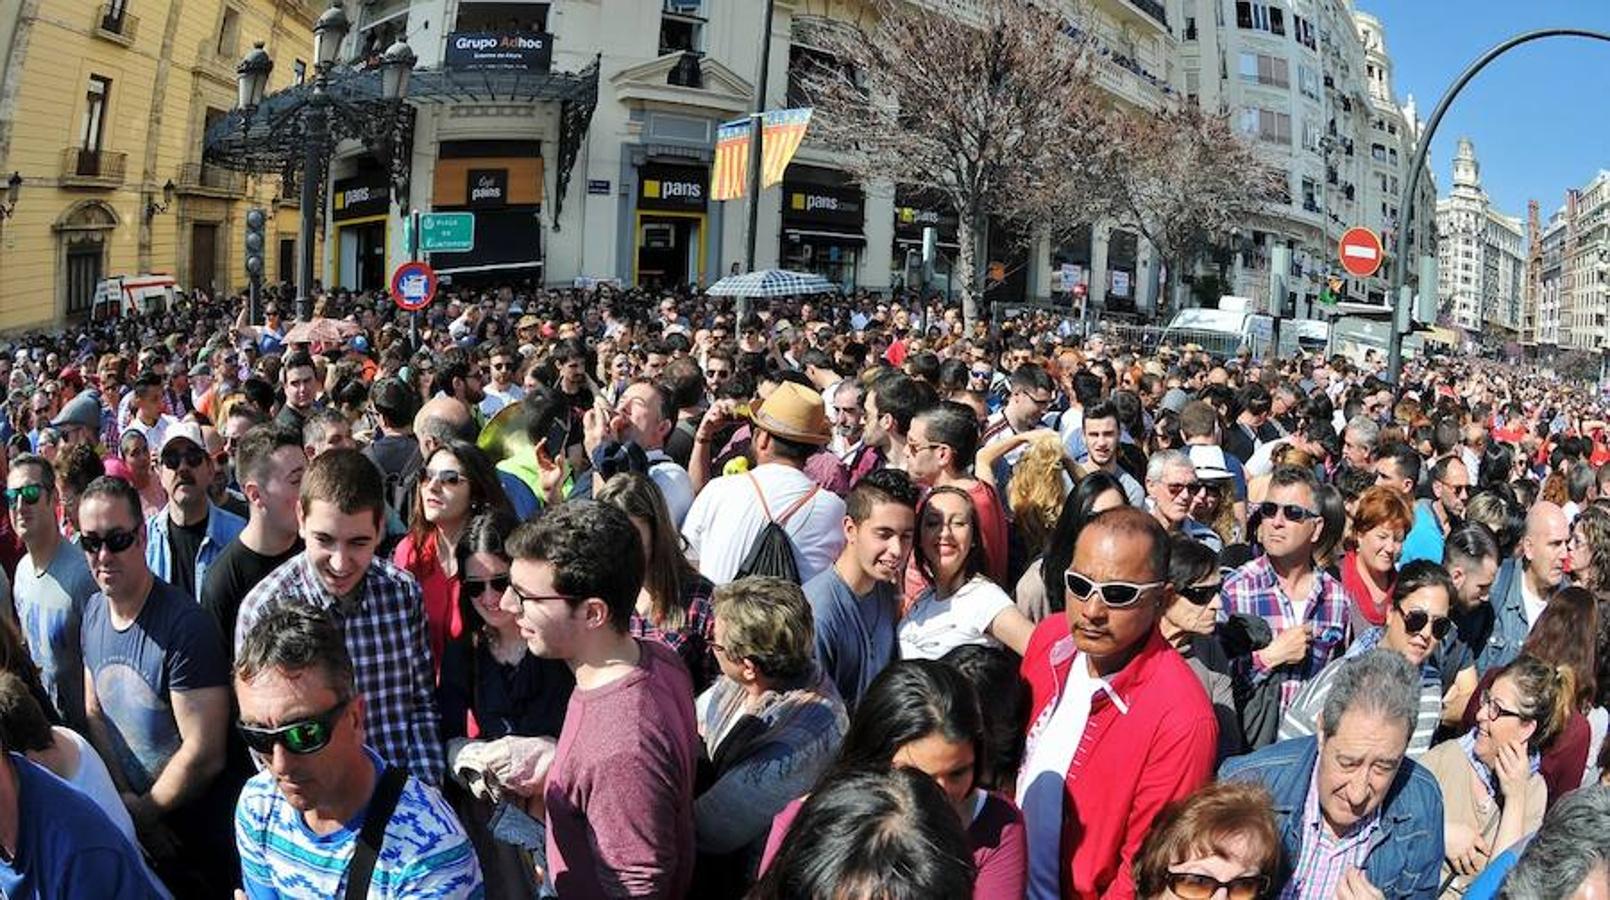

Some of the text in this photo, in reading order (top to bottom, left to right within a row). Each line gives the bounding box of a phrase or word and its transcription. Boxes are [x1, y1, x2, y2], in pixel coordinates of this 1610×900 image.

[455, 36, 543, 50] Grupo Adhoc
[345, 187, 369, 209] pans
[472, 187, 501, 201] pans
[662, 181, 702, 199] pans
[806, 195, 839, 211] pans
